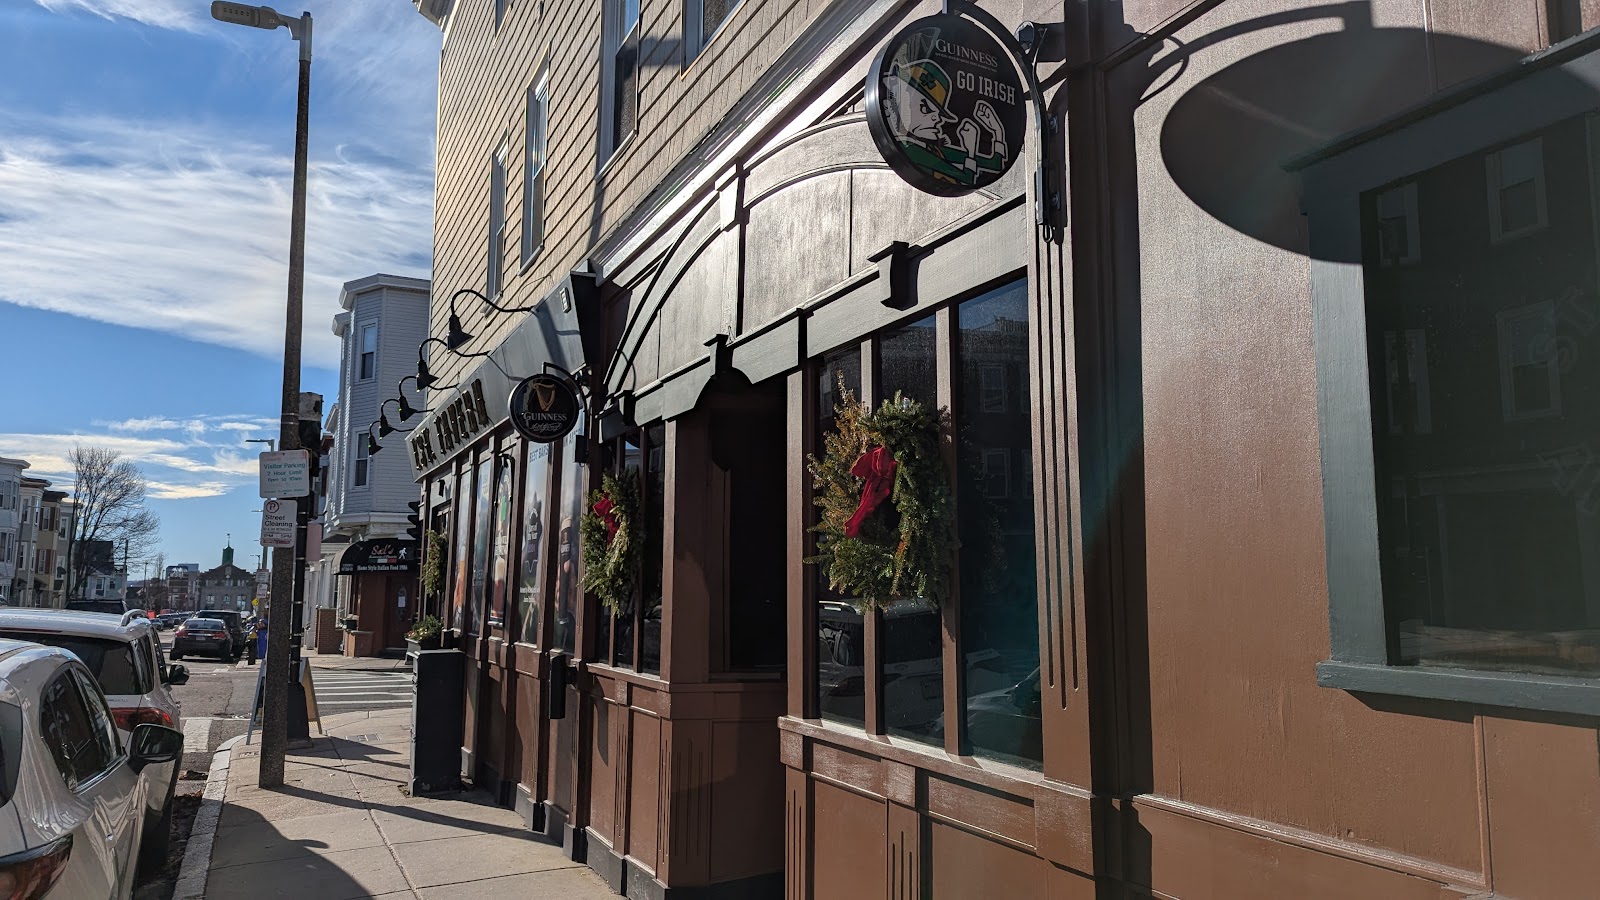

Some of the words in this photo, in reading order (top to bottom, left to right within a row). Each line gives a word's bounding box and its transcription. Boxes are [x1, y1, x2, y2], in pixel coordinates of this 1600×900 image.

[935, 38, 998, 68] GUINNESS
[956, 69, 975, 92] GO
[978, 76, 1016, 106] IRISH
[432, 379, 490, 455] TAVERN
[523, 411, 568, 421] GUINNESS
[264, 520, 293, 528] Cleaning
[371, 544, 394, 556] Sal's
[368, 564, 377, 572] Style
